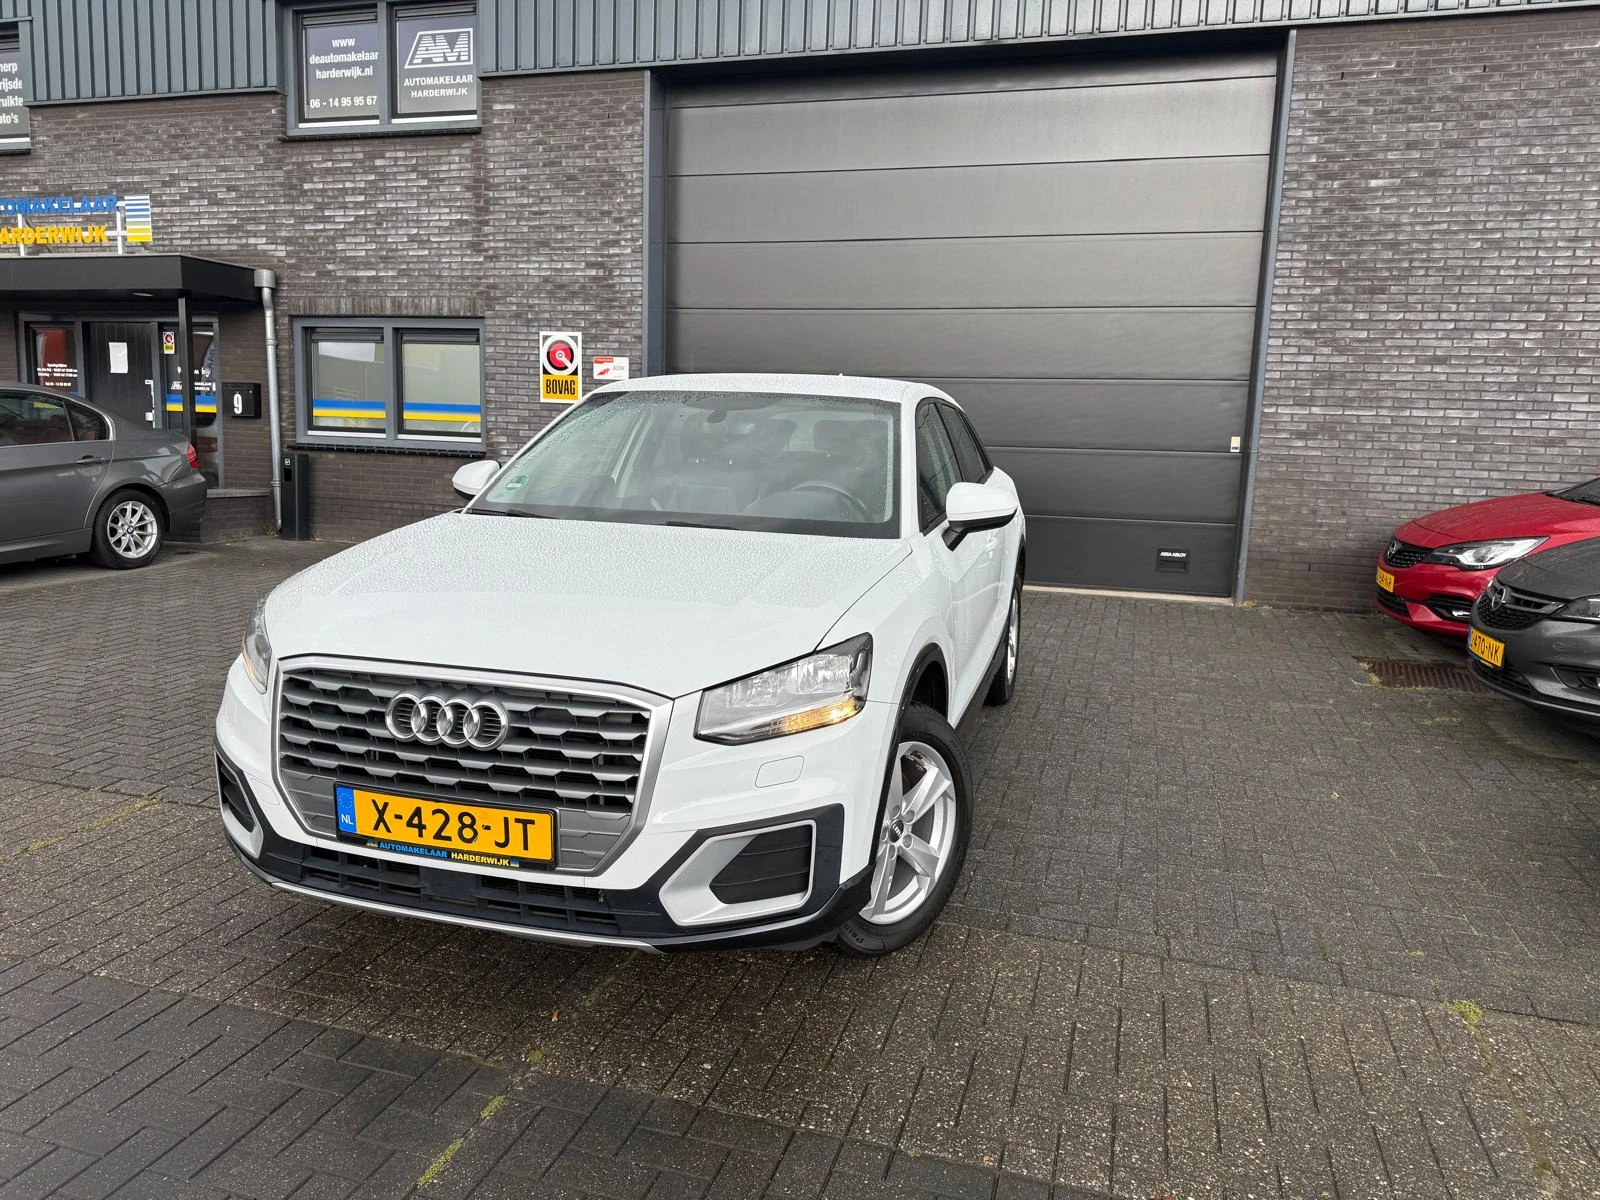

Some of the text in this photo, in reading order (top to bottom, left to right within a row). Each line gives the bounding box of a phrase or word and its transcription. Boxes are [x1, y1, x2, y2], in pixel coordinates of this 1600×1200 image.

[331, 37, 356, 48] www
[309, 50, 379, 64] deautomakelaar
[315, 65, 374, 80] harderwijk.nl
[403, 74, 474, 87] AUTOMAKELAAR
[411, 87, 468, 98] HARDERWIJK
[309, 98, 321, 109] 06
[329, 97, 339, 108] 14
[341, 96, 352, 107] 95
[353, 96, 365, 106] 95
[366, 95, 378, 106] 67
[545, 379, 576, 395] BOVAG
[233, 393, 243, 415] 9
[340, 813, 354, 825] NL
[371, 798, 536, 851] X-428-JT
[379, 842, 448, 858] AUTOMAKELAAR
[451, 852, 510, 867] HARDERWIJK
